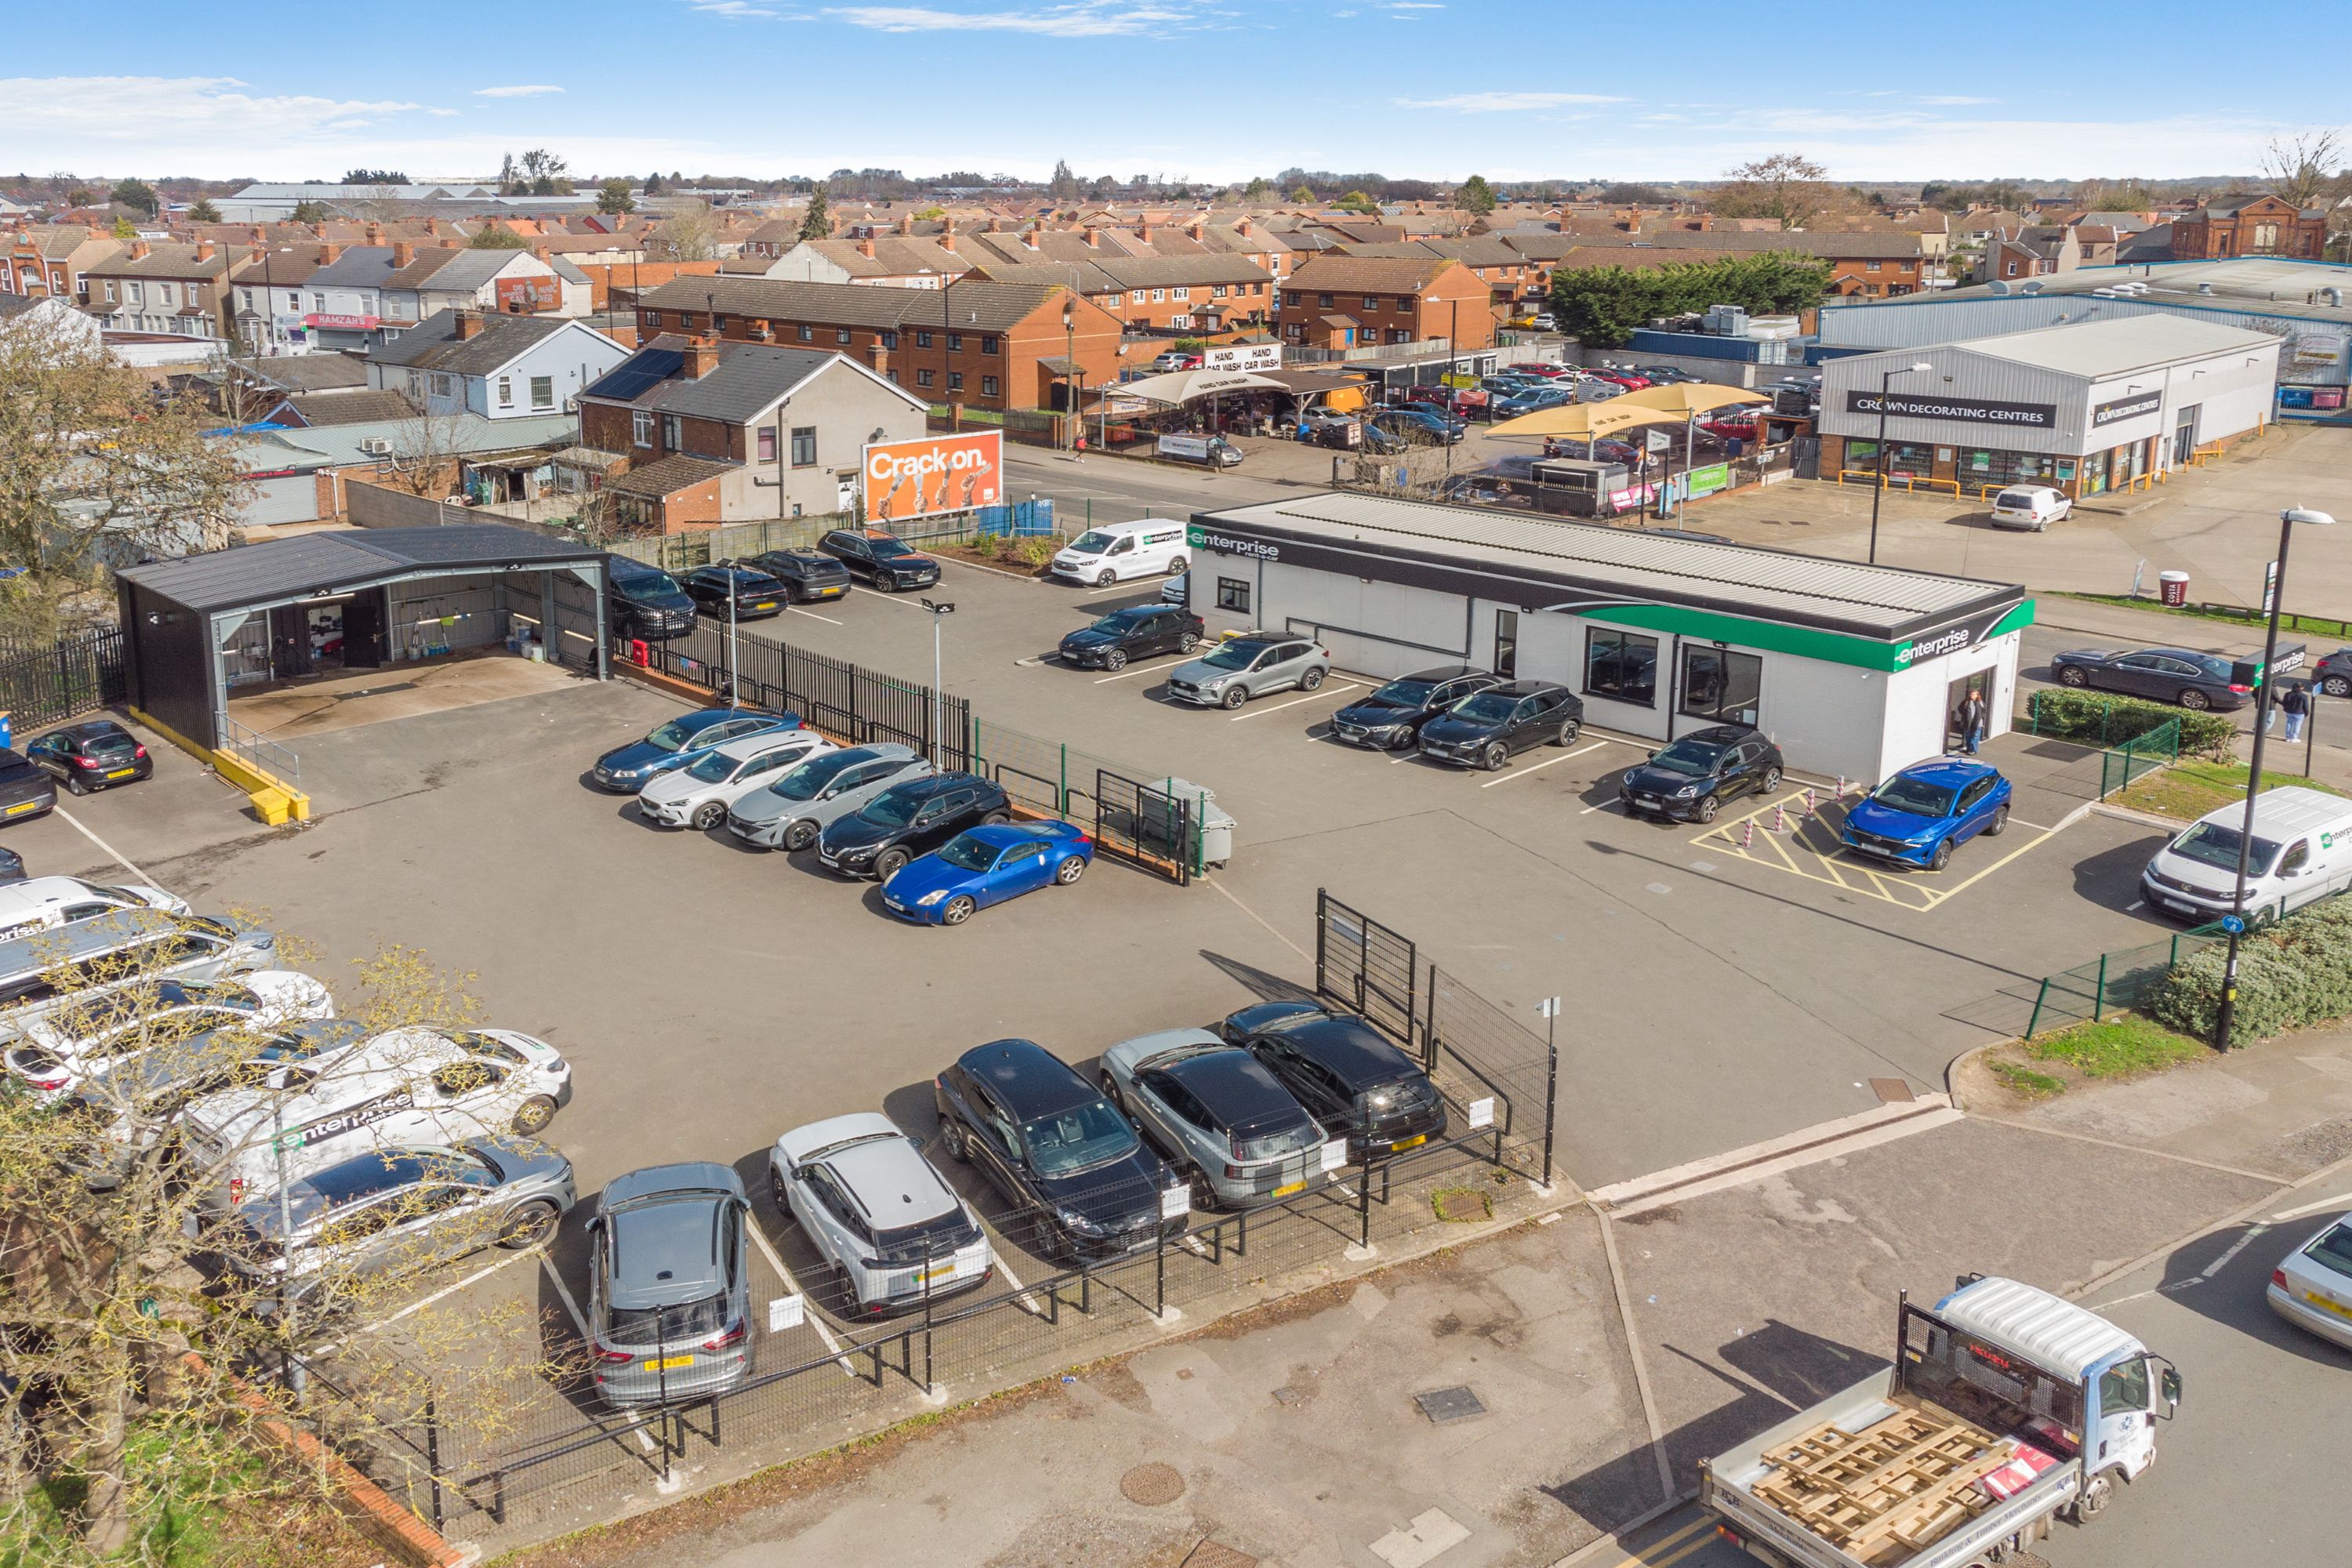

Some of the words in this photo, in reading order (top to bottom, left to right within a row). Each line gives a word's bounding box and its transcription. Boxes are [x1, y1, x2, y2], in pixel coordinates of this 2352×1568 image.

[539, 284, 558, 294] PANIC
[318, 315, 365, 325] HAMZAH'S
[1214, 352, 1234, 361] HAND
[1252, 348, 1271, 358] HAND
[1222, 362, 1242, 372] WASH
[1244, 361, 1258, 370] CAR
[1261, 358, 1279, 368] WASH
[1910, 404, 1987, 419] DECORATING
[1989, 410, 2044, 423] CENTRES
[869, 447, 949, 479] Crack
[952, 448, 987, 470] on.
[1144, 532, 1182, 543] enterprise
[1187, 532, 1279, 556] enterprise
[1245, 551, 1279, 561] rent-a-car
[1894, 630, 1969, 663] enterprise
[2255, 652, 2305, 681] eterprise
[2321, 826, 2352, 844] enterp
[1929, 1540, 1965, 1567] Building
